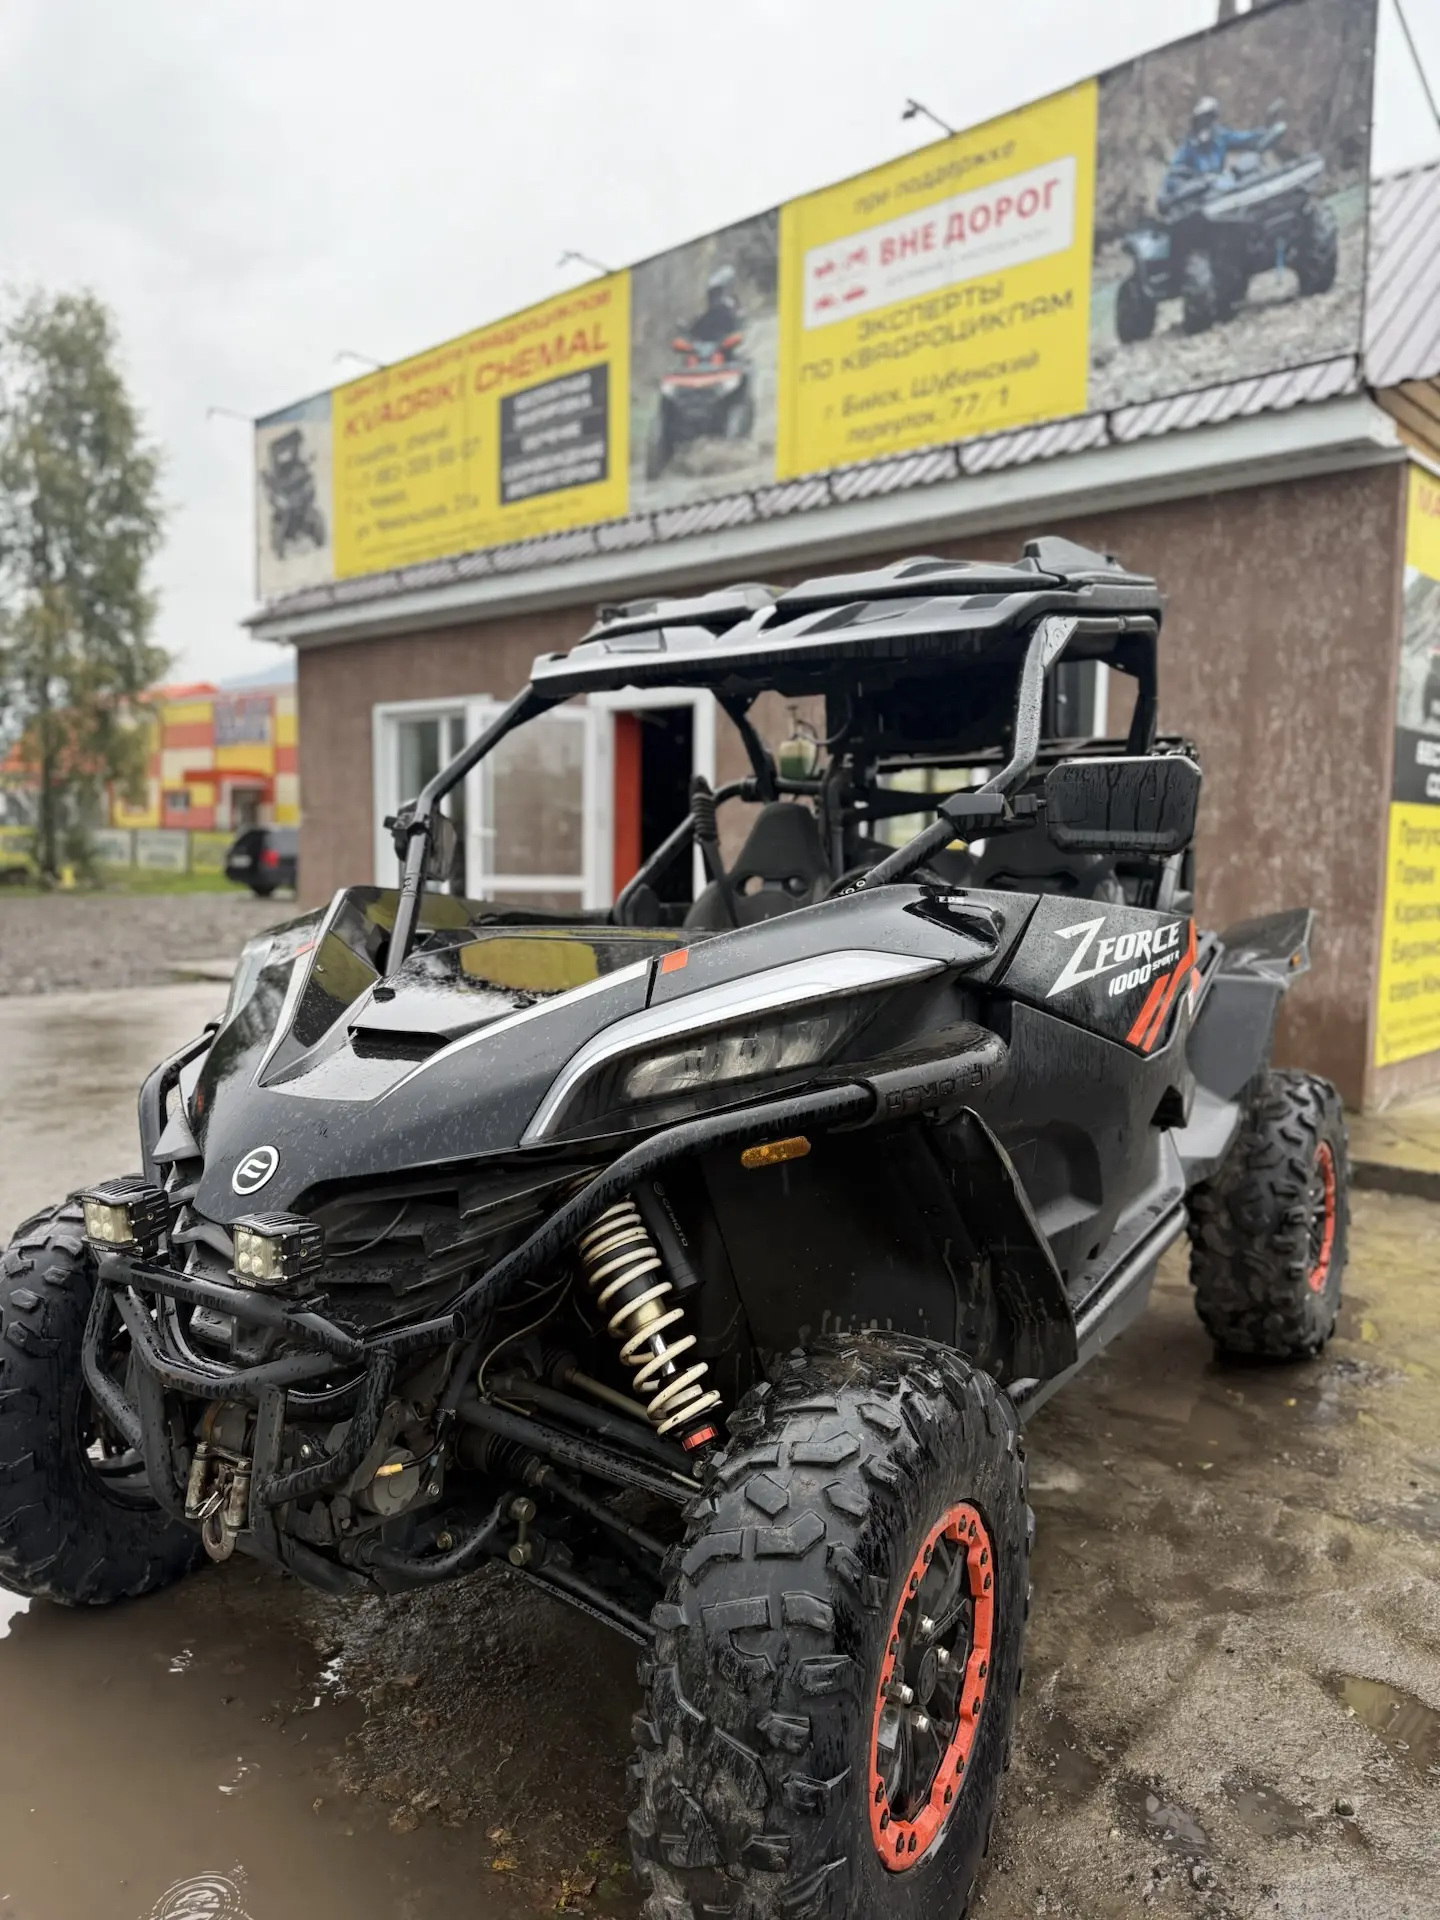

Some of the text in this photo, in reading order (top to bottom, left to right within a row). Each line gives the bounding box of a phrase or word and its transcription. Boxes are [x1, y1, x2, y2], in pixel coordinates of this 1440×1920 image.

[879, 221, 937, 267] ВНЕ
[942, 178, 1061, 250] ДОРОГ
[840, 287, 1074, 373] КВАДРОЦИКЛАМ
[856, 280, 1005, 341] ЭКСПЕРТЫ
[473, 321, 610, 395] CHEMAL
[1108, 963, 1152, 998] 1000
